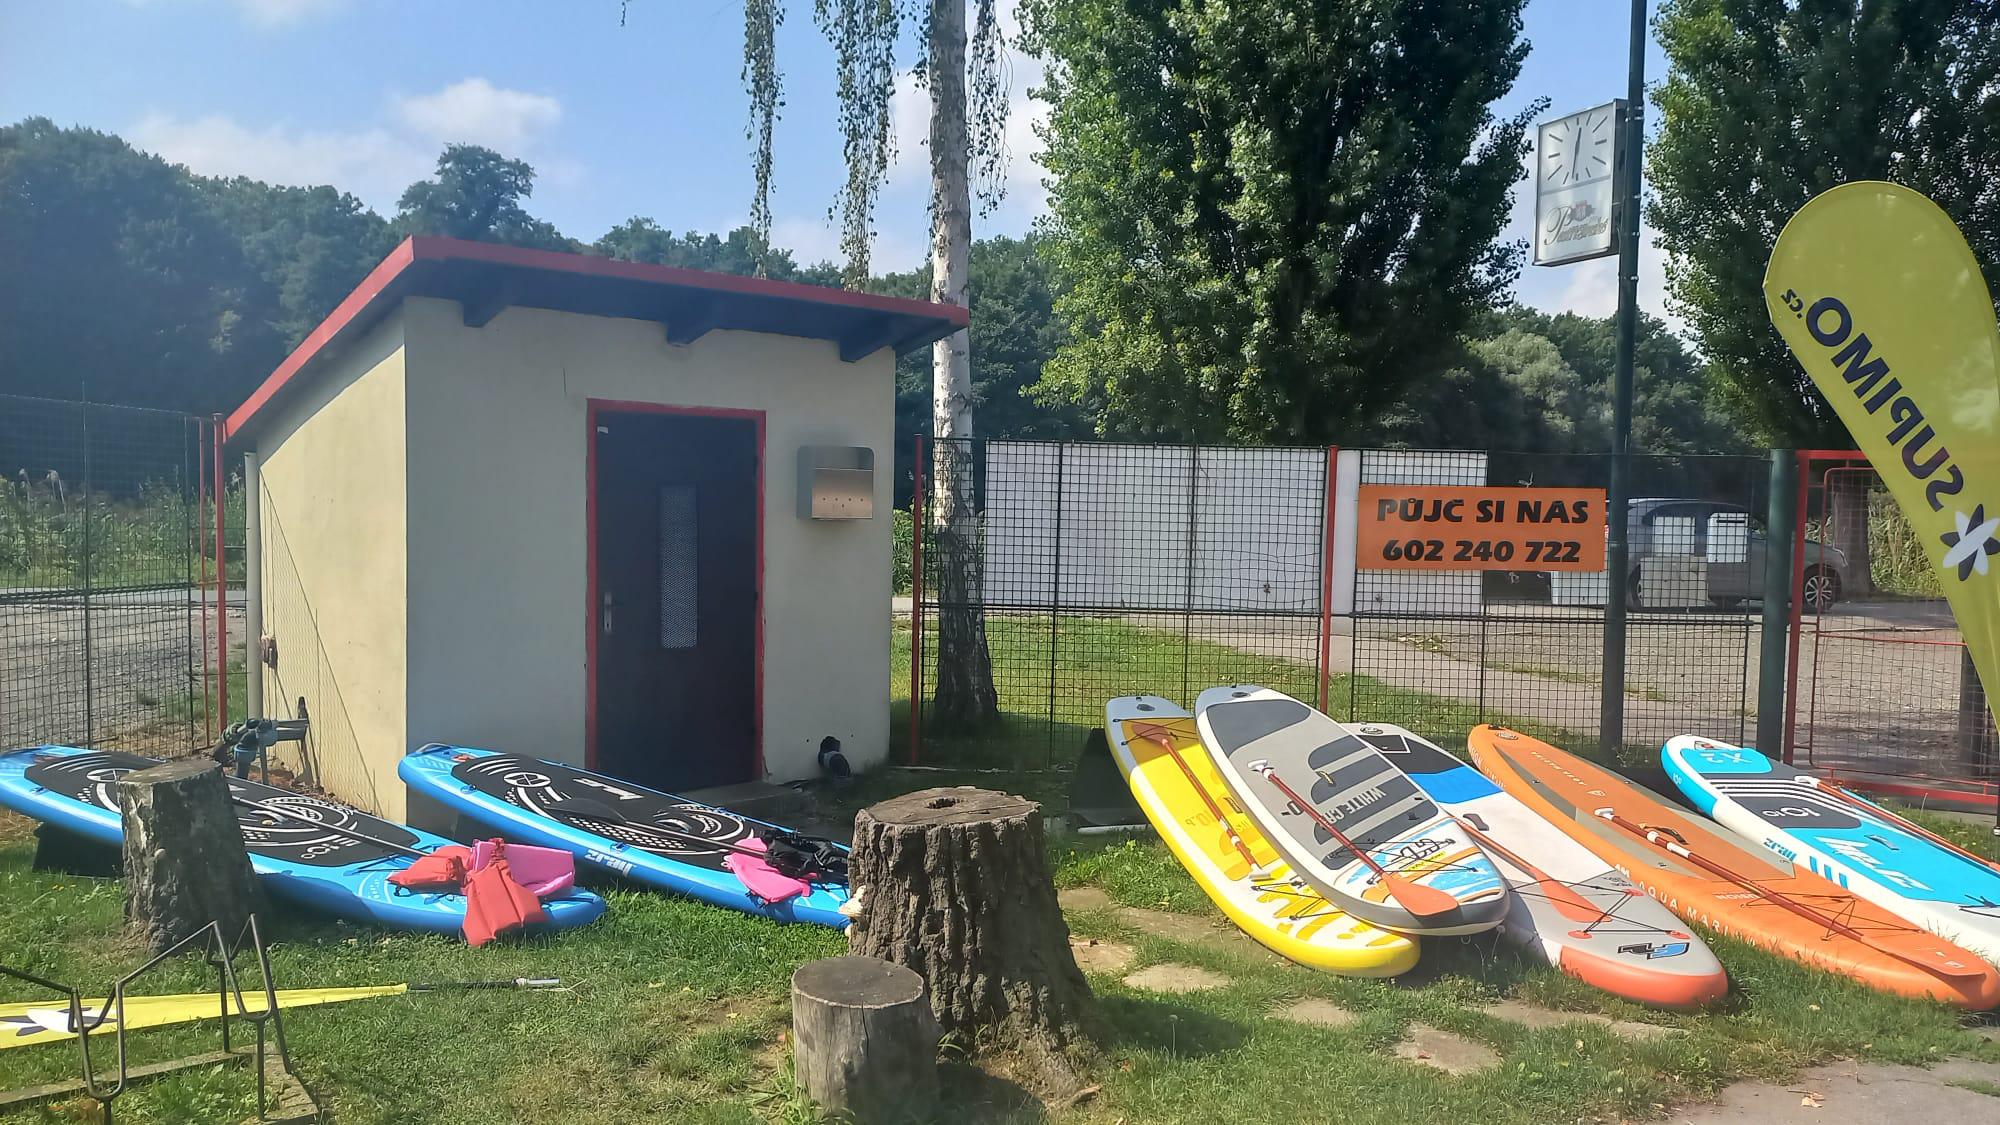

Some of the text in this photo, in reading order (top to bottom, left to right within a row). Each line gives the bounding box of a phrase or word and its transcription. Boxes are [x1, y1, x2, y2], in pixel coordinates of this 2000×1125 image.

[1377, 498, 1464, 522] PŮJČ
[1476, 500, 1504, 523] SI
[1382, 539, 1581, 563] 602 240 722
[1346, 786, 1387, 815] WHITE
